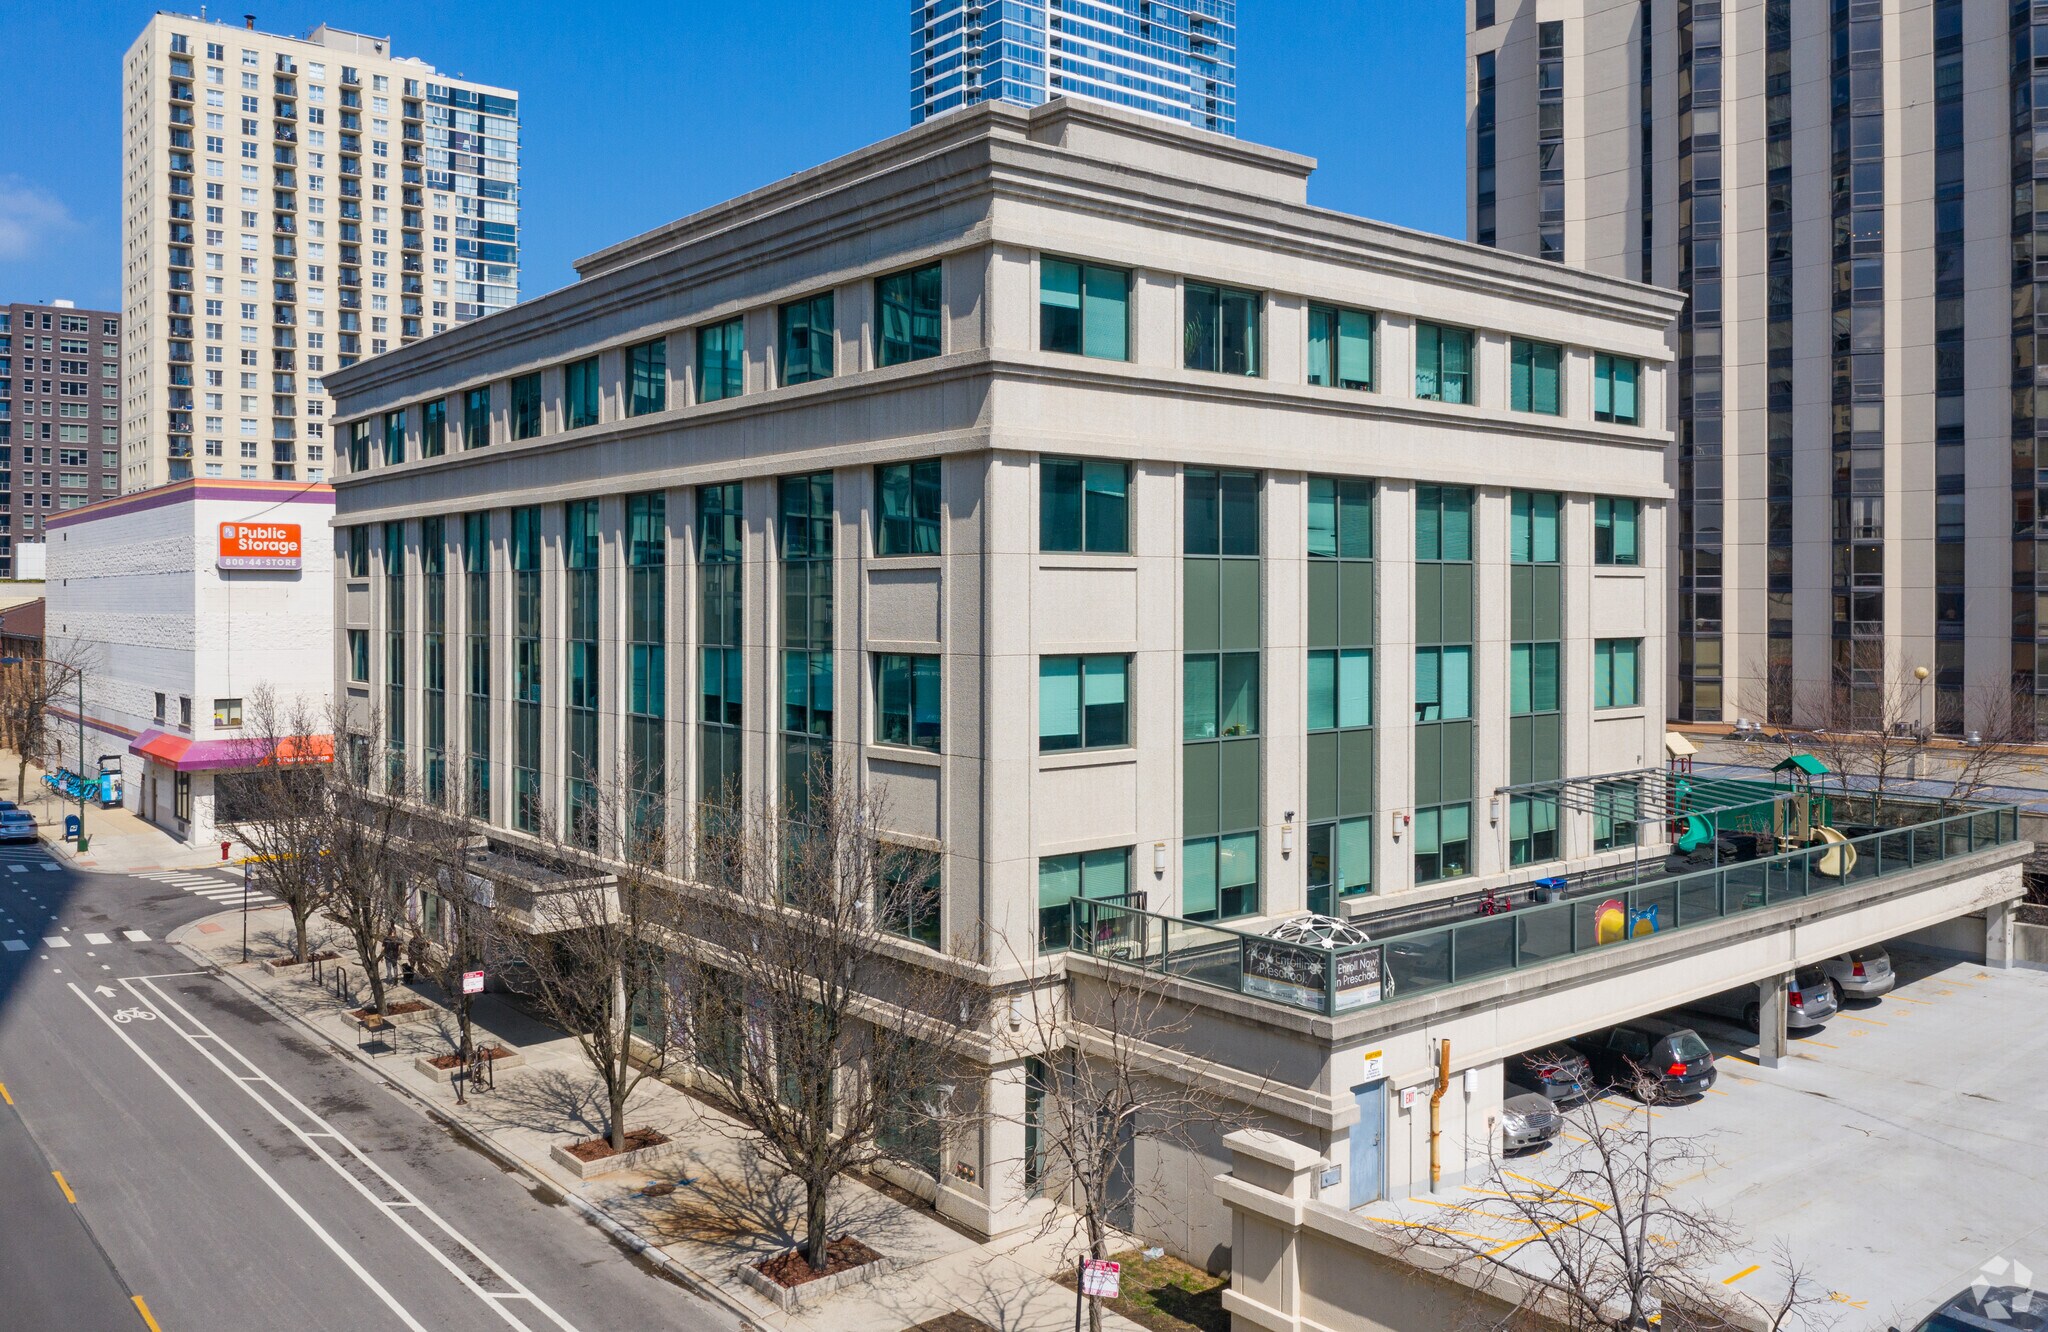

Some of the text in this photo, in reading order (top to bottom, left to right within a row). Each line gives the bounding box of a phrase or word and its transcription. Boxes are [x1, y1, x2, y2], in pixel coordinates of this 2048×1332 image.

[238, 526, 287, 539] Public
[238, 538, 298, 554] Storage
[1360, 958, 1378, 970] Now
